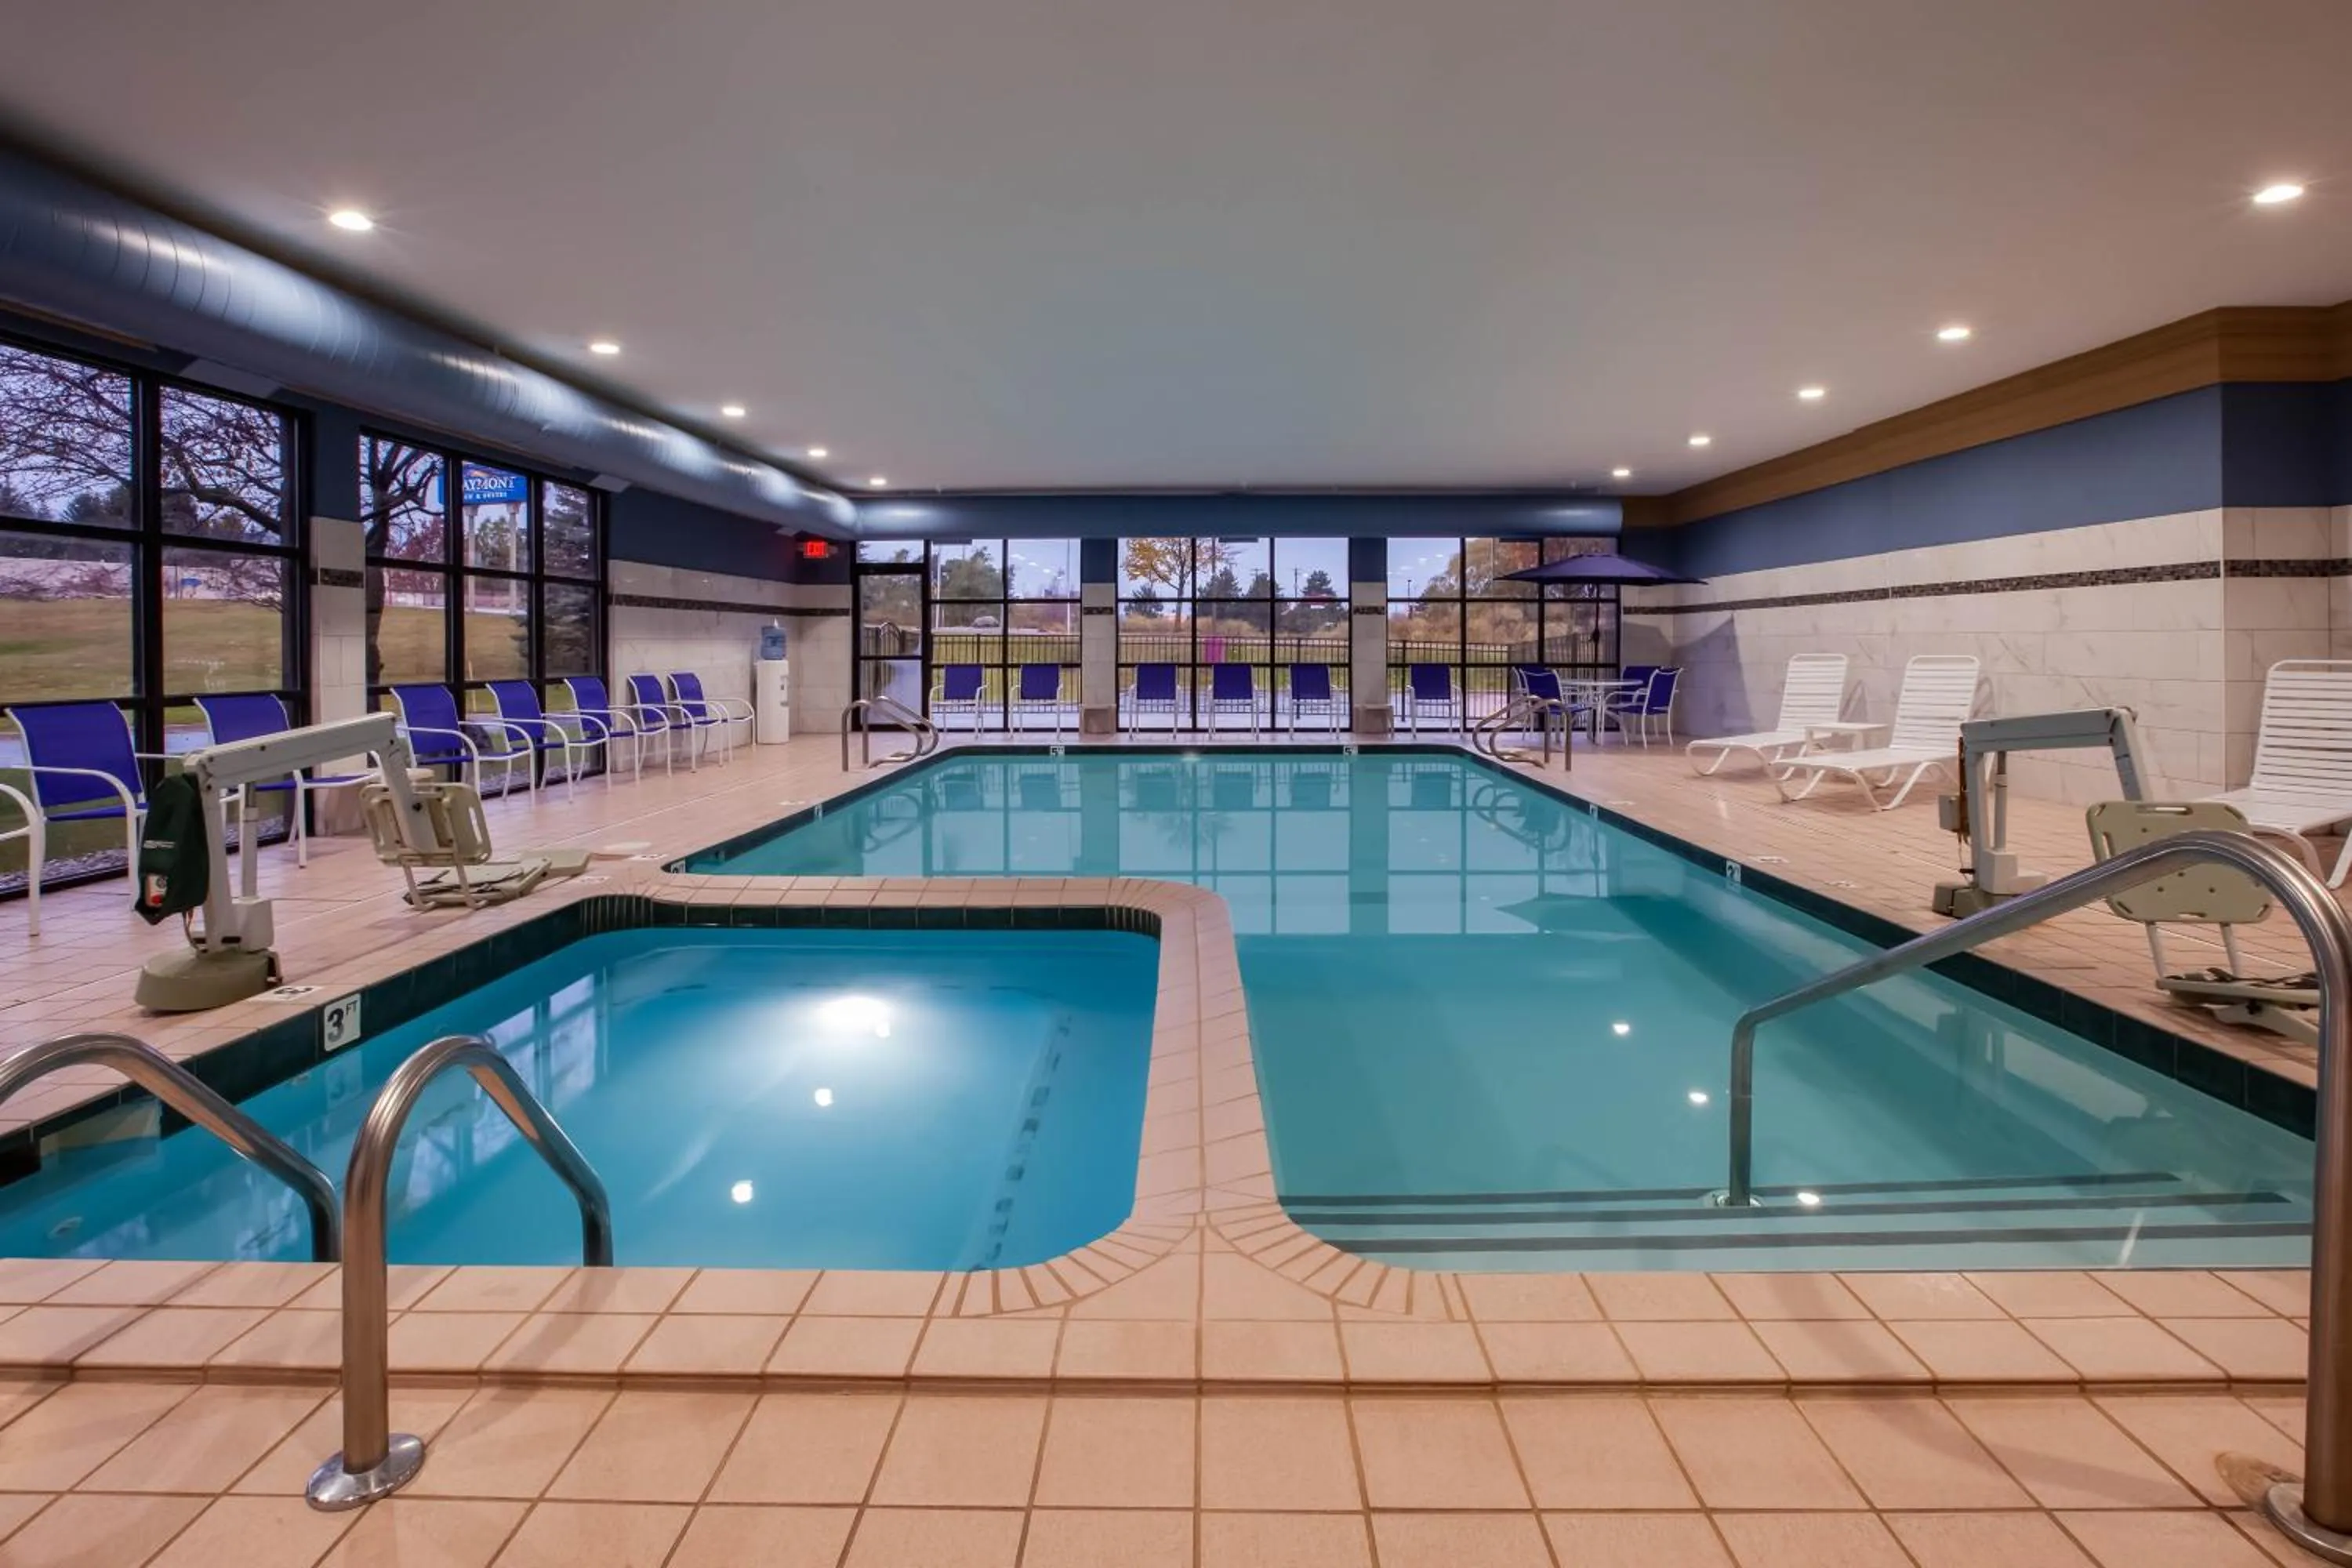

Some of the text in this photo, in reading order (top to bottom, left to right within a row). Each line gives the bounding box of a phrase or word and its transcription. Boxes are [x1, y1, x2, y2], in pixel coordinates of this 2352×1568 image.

[463, 476, 516, 491] AYMONT
[327, 1000, 358, 1042] 3 FT
